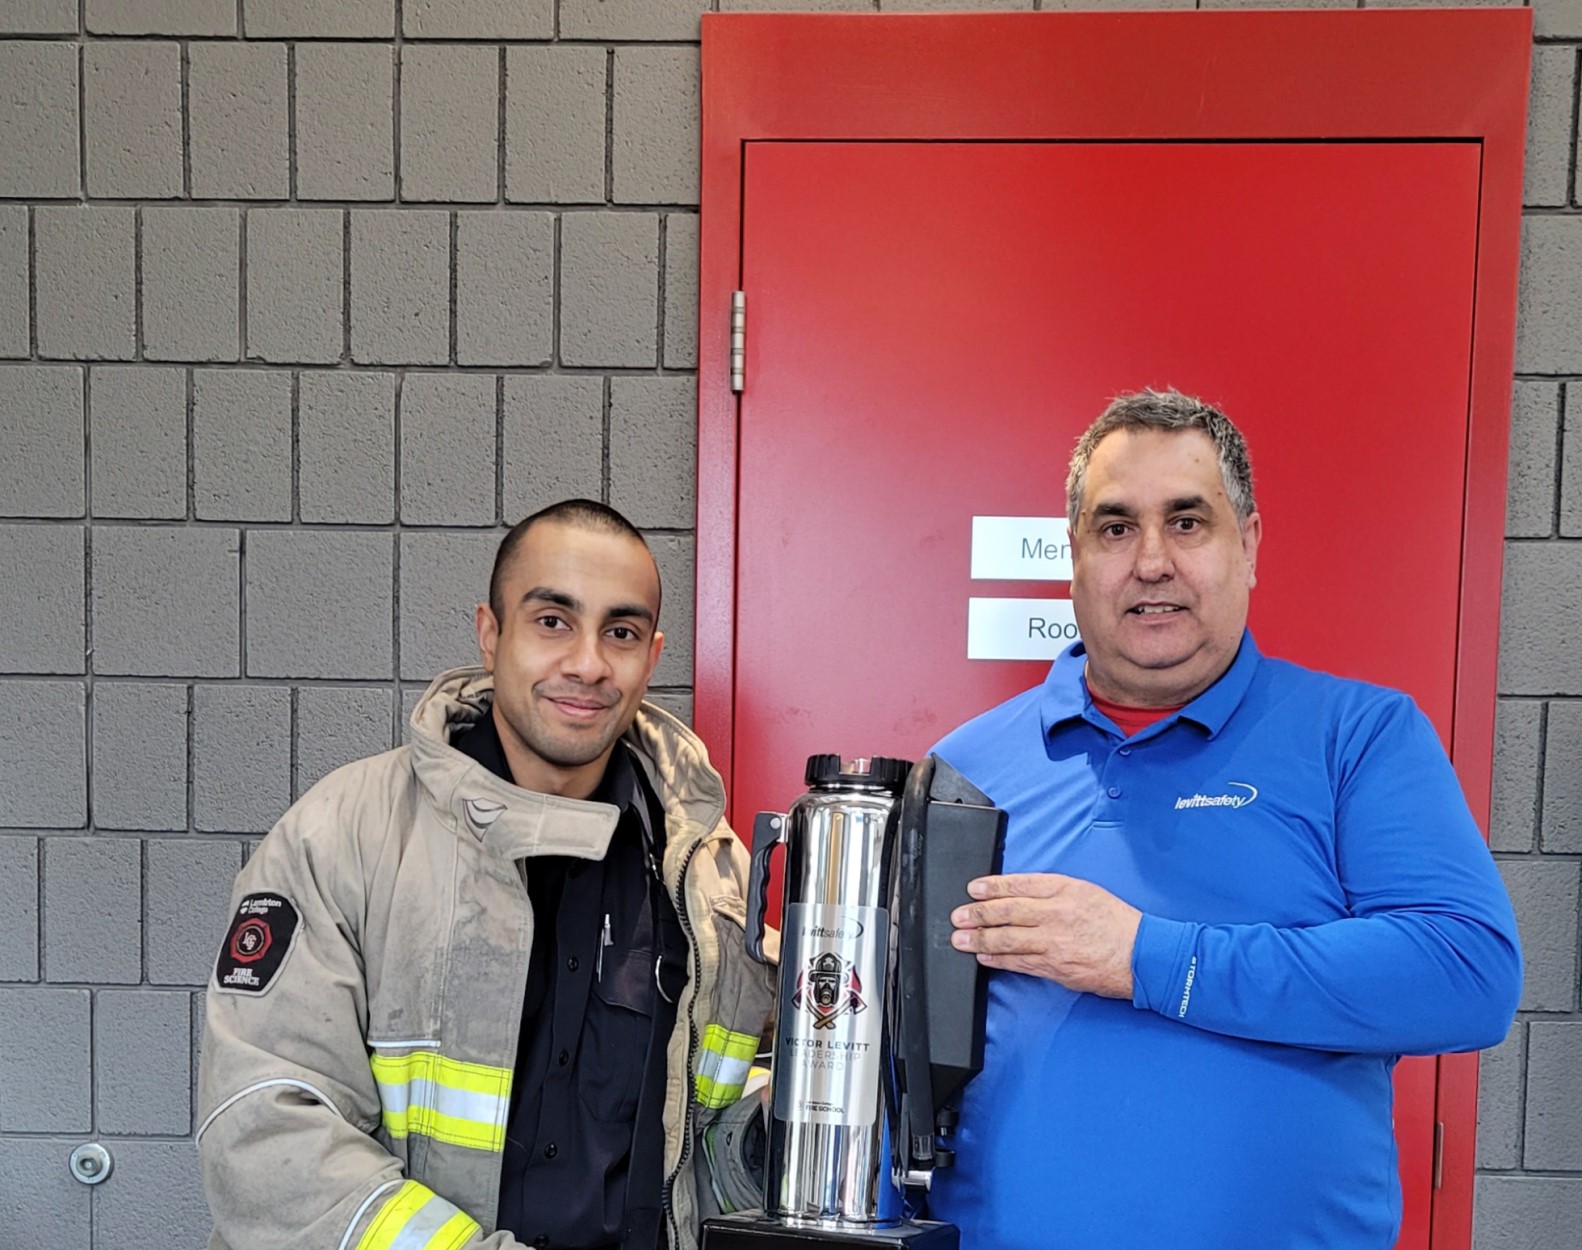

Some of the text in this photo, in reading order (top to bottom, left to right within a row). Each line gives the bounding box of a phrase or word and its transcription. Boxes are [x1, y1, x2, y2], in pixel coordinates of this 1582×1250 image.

[1028, 617, 1082, 639] Roo
[1174, 793, 1246, 809] levittsafety
[250, 898, 282, 907] Lambton
[802, 925, 854, 939] lvittsafey
[233, 968, 253, 976] FIRE
[224, 976, 260, 985] SCIENCE
[1178, 955, 1197, 1018] STORMTECH
[785, 1036, 870, 1051] VICTOR LEVITT
[802, 1060, 844, 1070] AWARD
